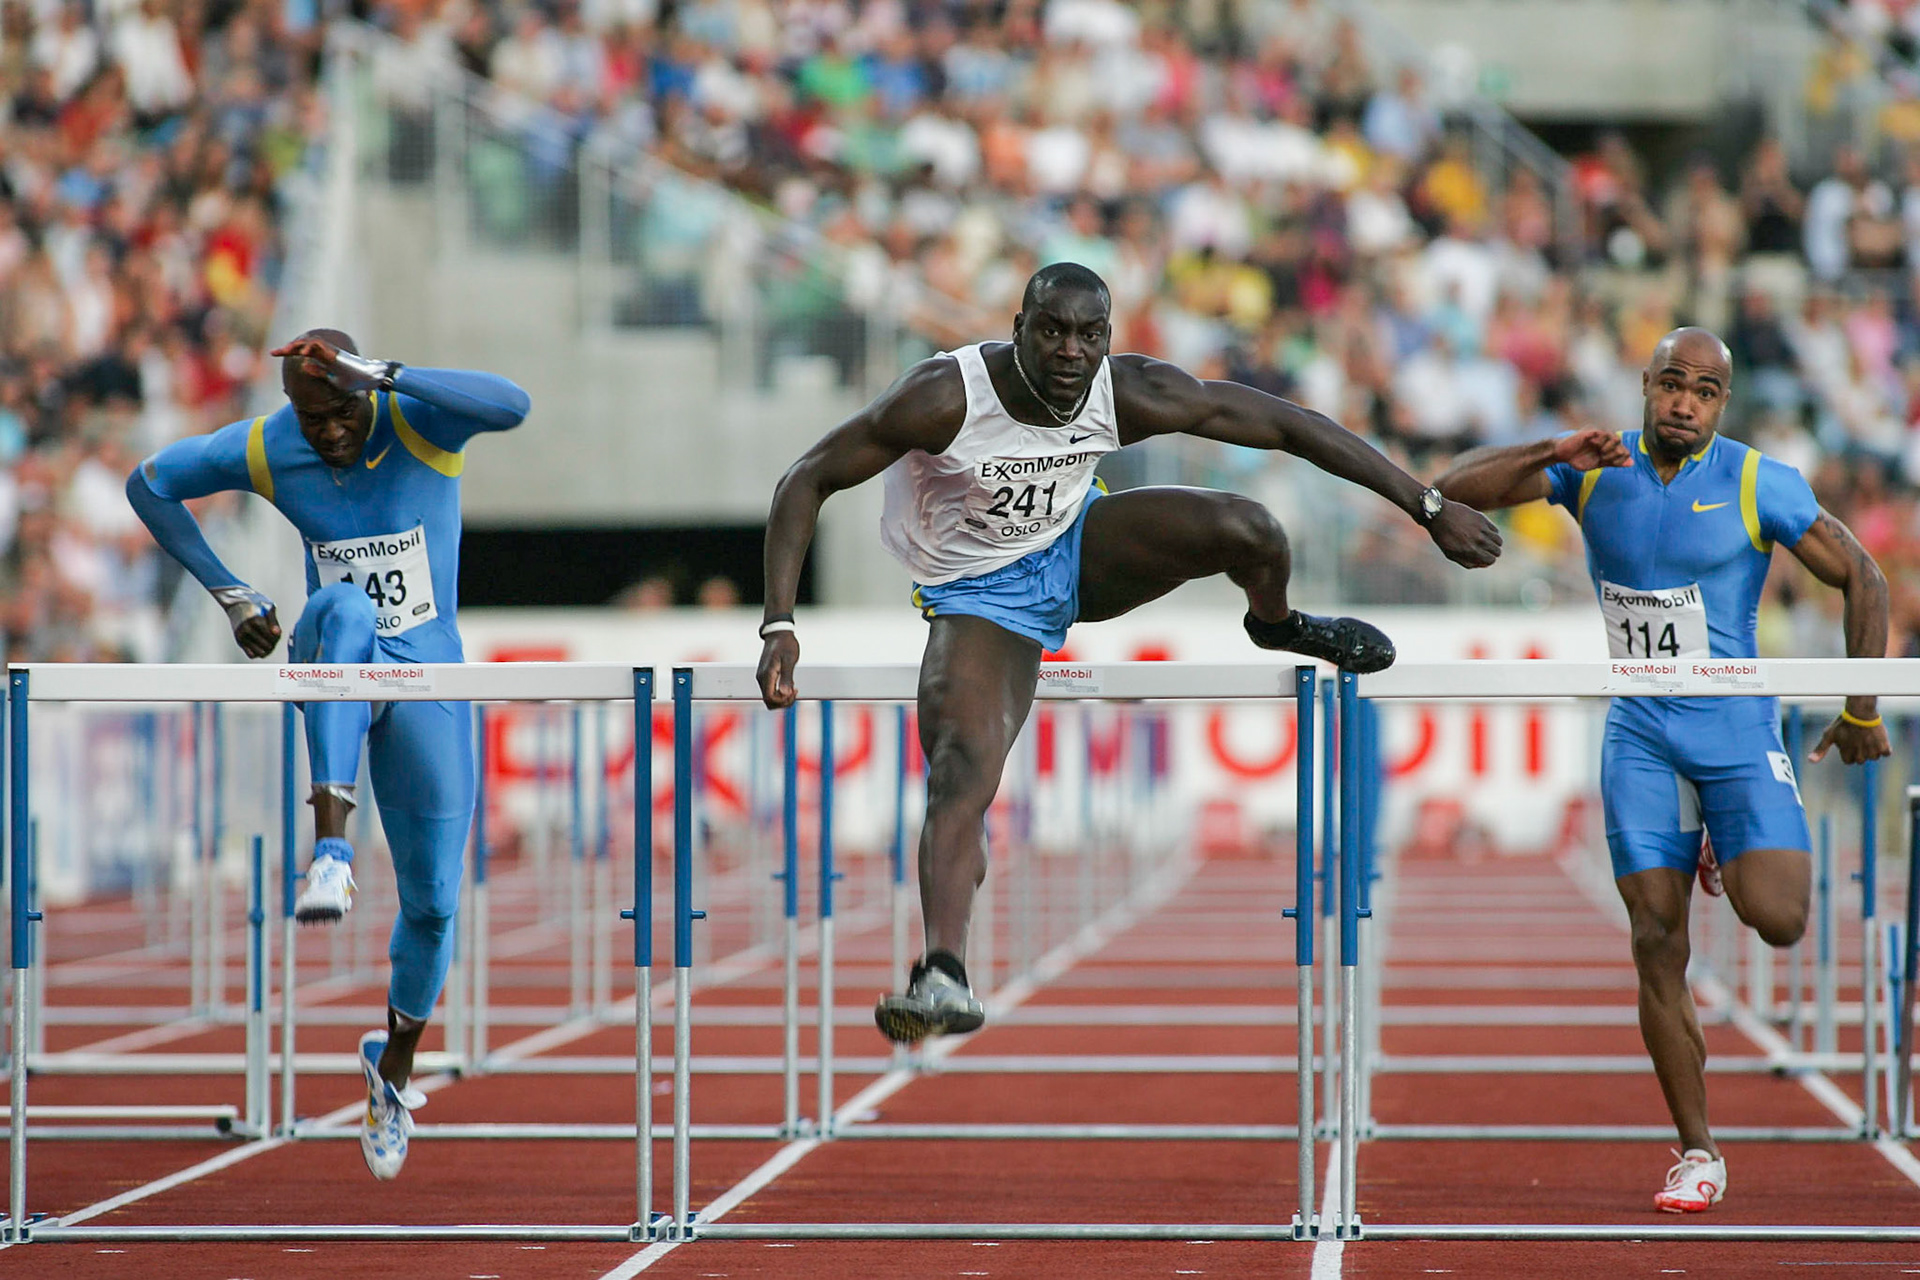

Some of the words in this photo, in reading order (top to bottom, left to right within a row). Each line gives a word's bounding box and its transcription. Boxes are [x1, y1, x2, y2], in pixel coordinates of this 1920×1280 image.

[981, 452, 1088, 480] ExxonMobil
[986, 480, 1057, 518] 241
[1001, 521, 1041, 537] OSLO
[317, 531, 420, 564] ExxonMobil
[375, 615, 401, 630] SLO
[1620, 618, 1680, 658] 114
[279, 668, 344, 681] ExxonMobil
[359, 669, 424, 681] ExxonMobil
[1612, 664, 1677, 677] ExxonMobil
[1692, 665, 1757, 678] ExxonMobil
